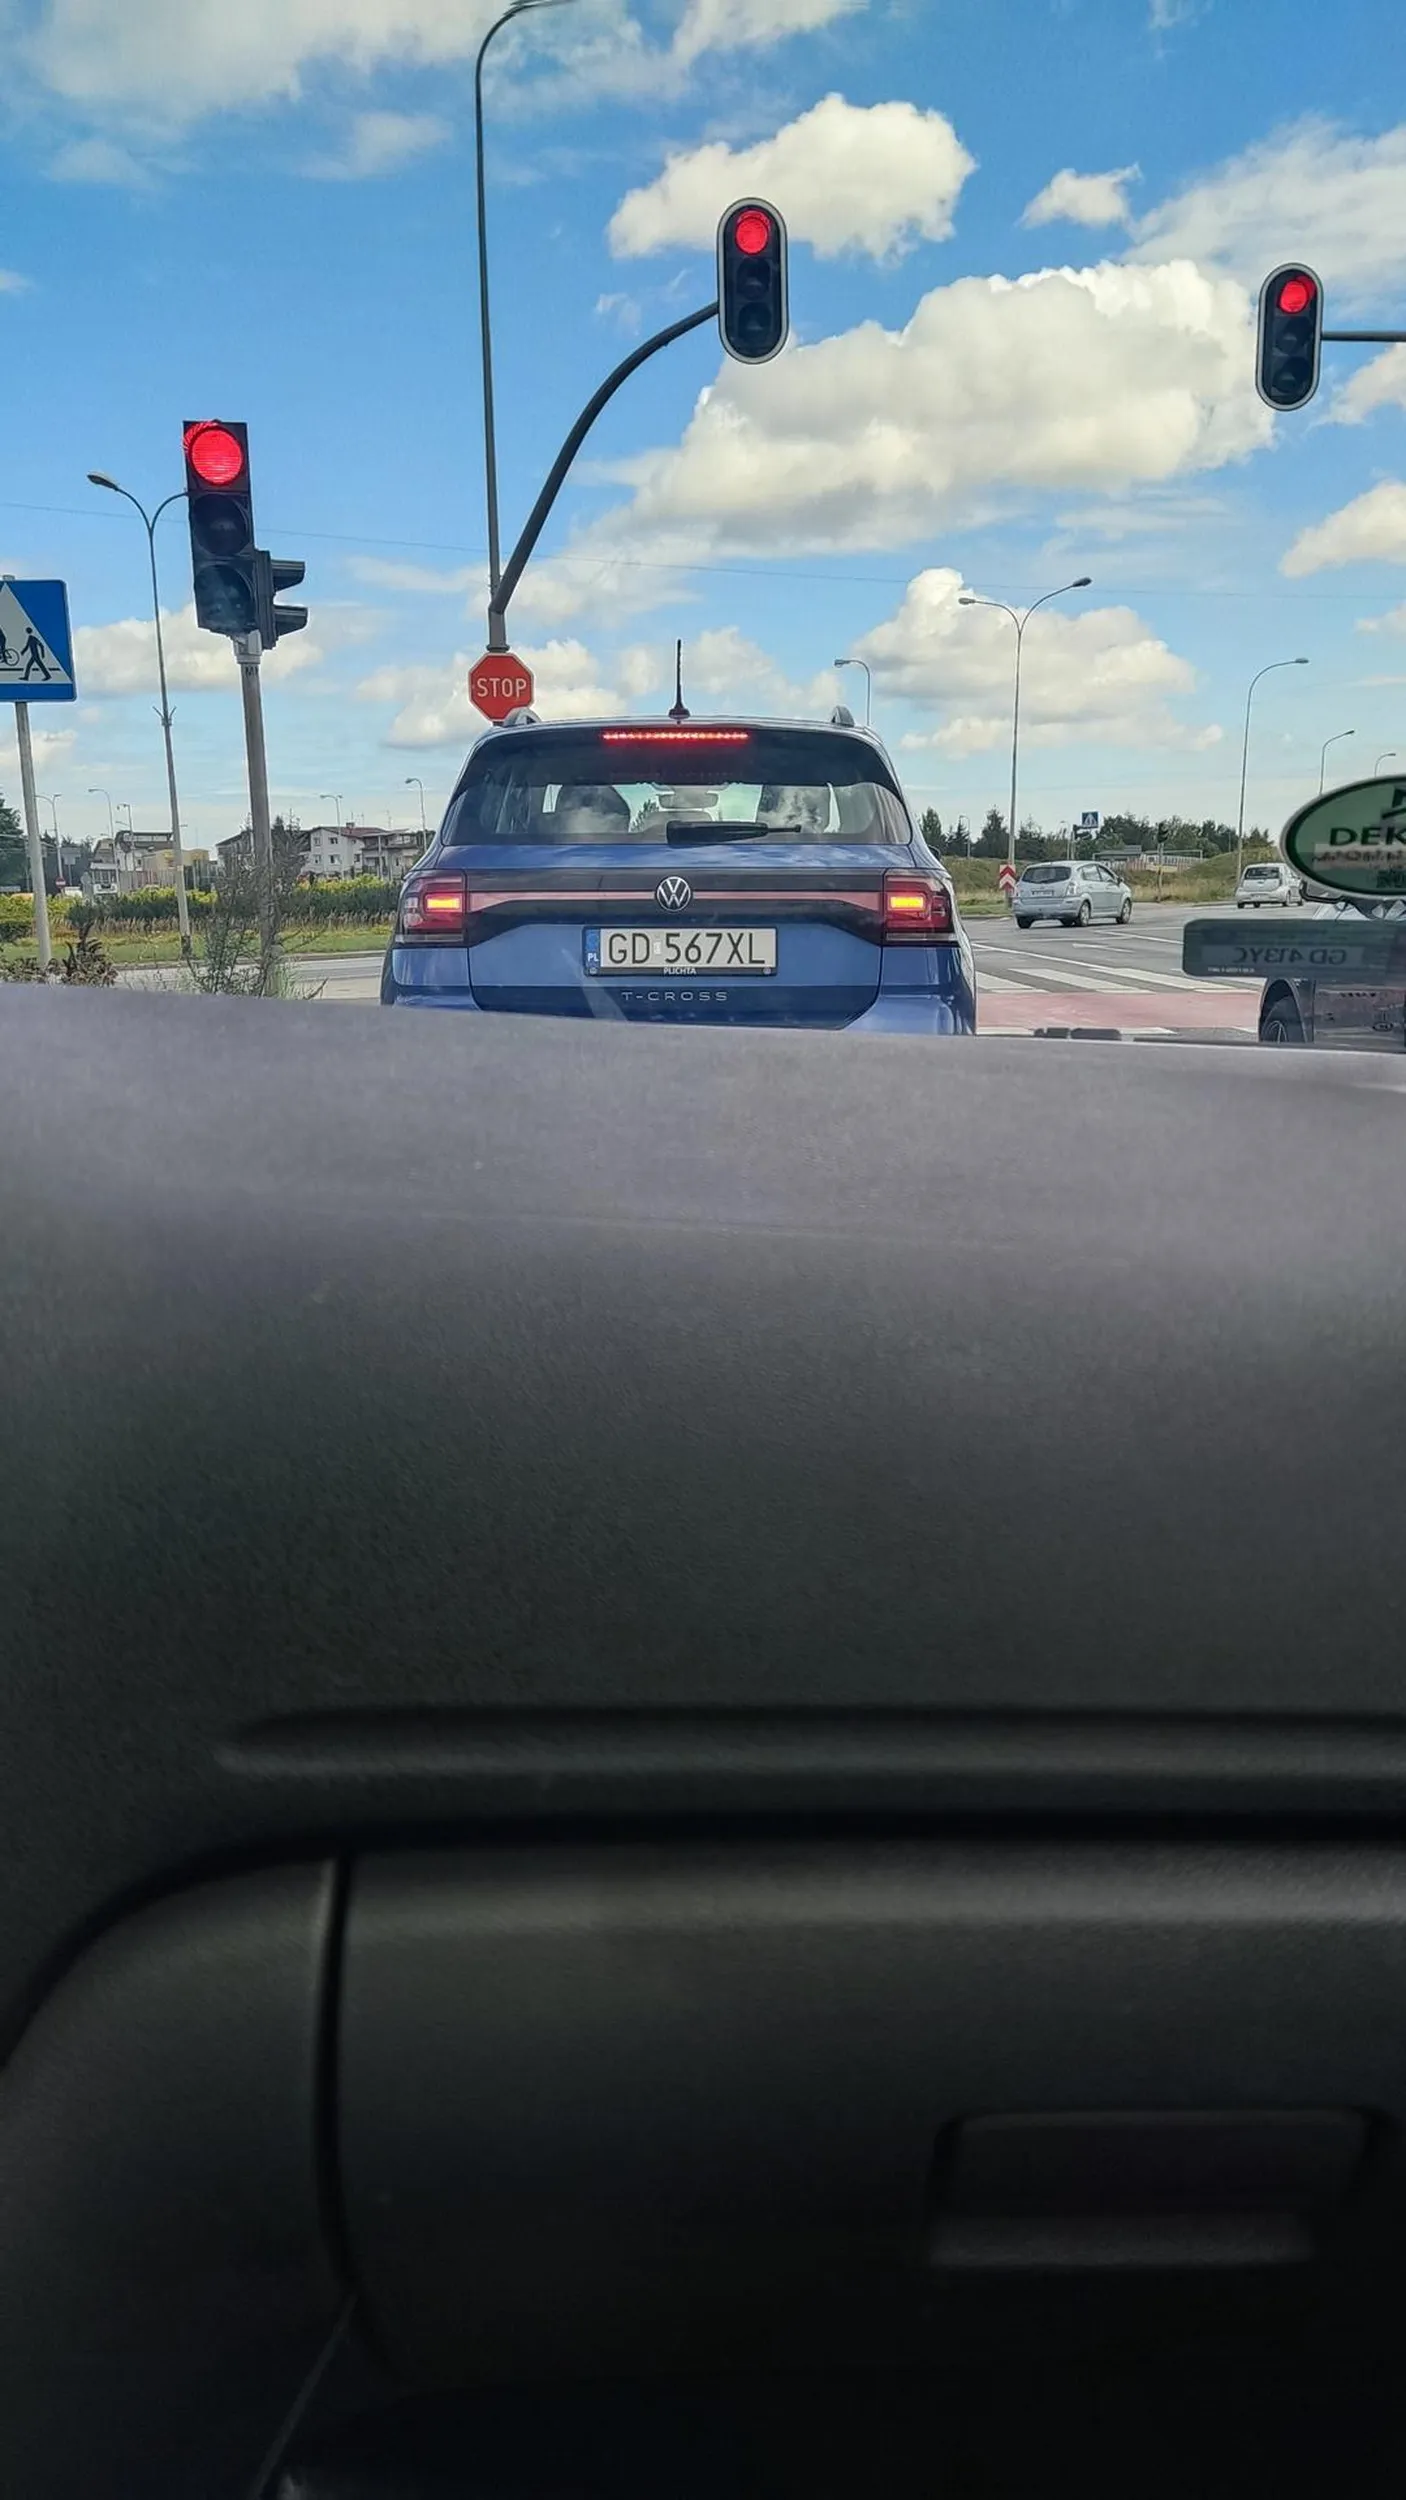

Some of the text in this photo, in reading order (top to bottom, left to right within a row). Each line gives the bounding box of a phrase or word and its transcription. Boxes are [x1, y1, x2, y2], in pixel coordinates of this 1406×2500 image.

[476, 677, 528, 699] STOP
[608, 932, 766, 965] GD 567XL
[587, 952, 599, 962] PL
[663, 966, 697, 976] PLICHTA
[621, 991, 728, 1001] T-CROSS
